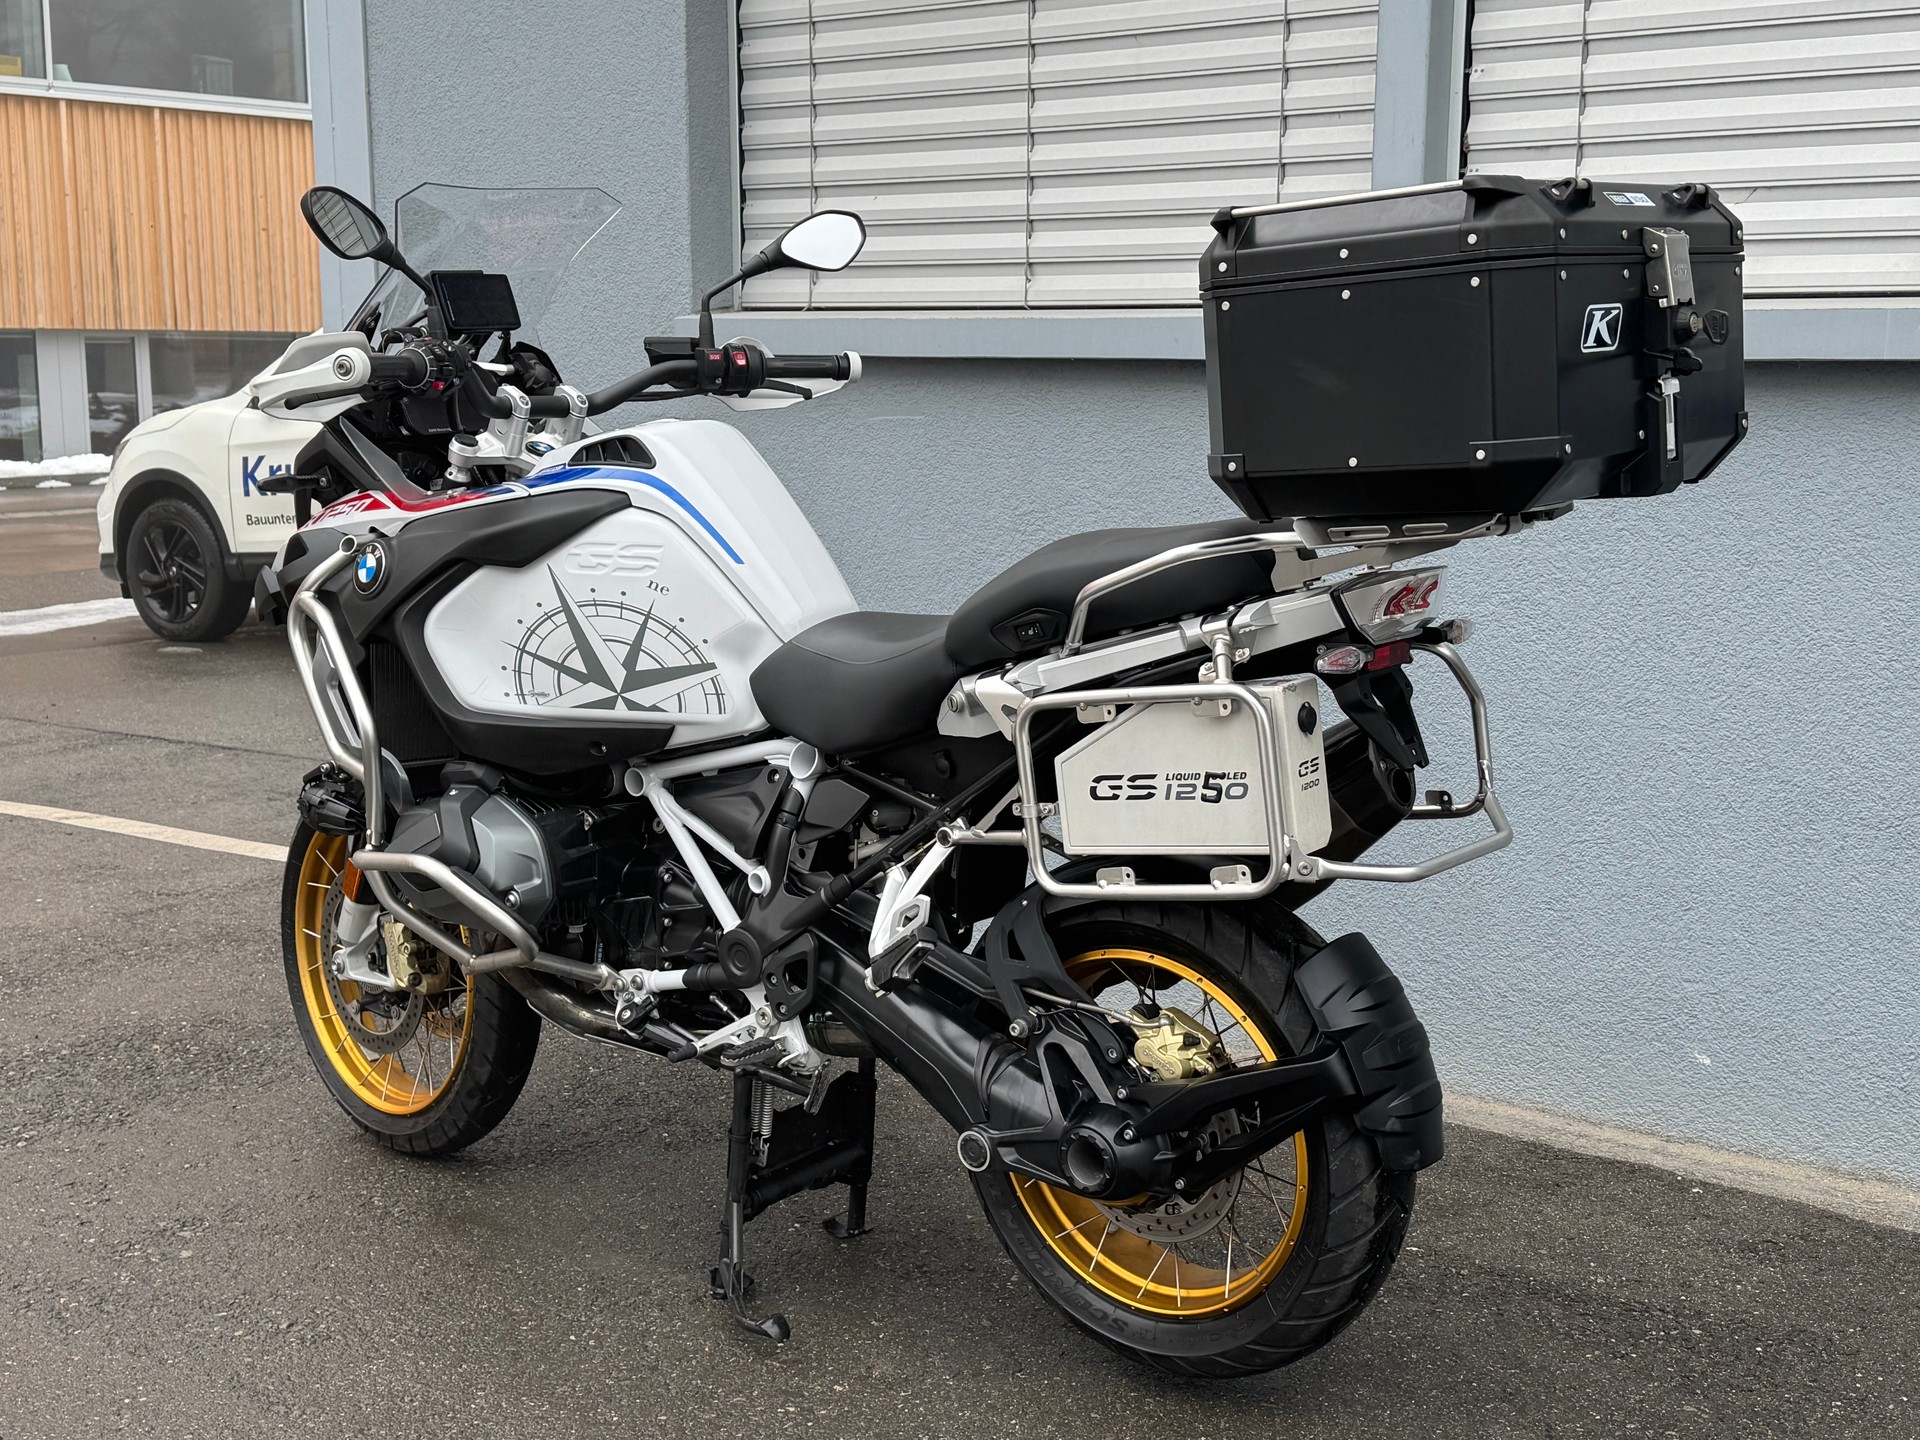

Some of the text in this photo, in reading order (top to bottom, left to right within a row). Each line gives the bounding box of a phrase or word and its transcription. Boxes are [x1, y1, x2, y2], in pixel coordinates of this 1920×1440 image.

[1582, 309, 1620, 348] K
[242, 455, 292, 498] Kr
[357, 545, 382, 563] BMW
[564, 542, 665, 577] GS
[645, 578, 671, 597] ne
[1165, 771, 1248, 782] LIQUID LED
[1298, 755, 1320, 778] GS
[1089, 773, 1158, 801] GS
[1165, 771, 1249, 804] 1250
[1300, 777, 1320, 792] 1200
